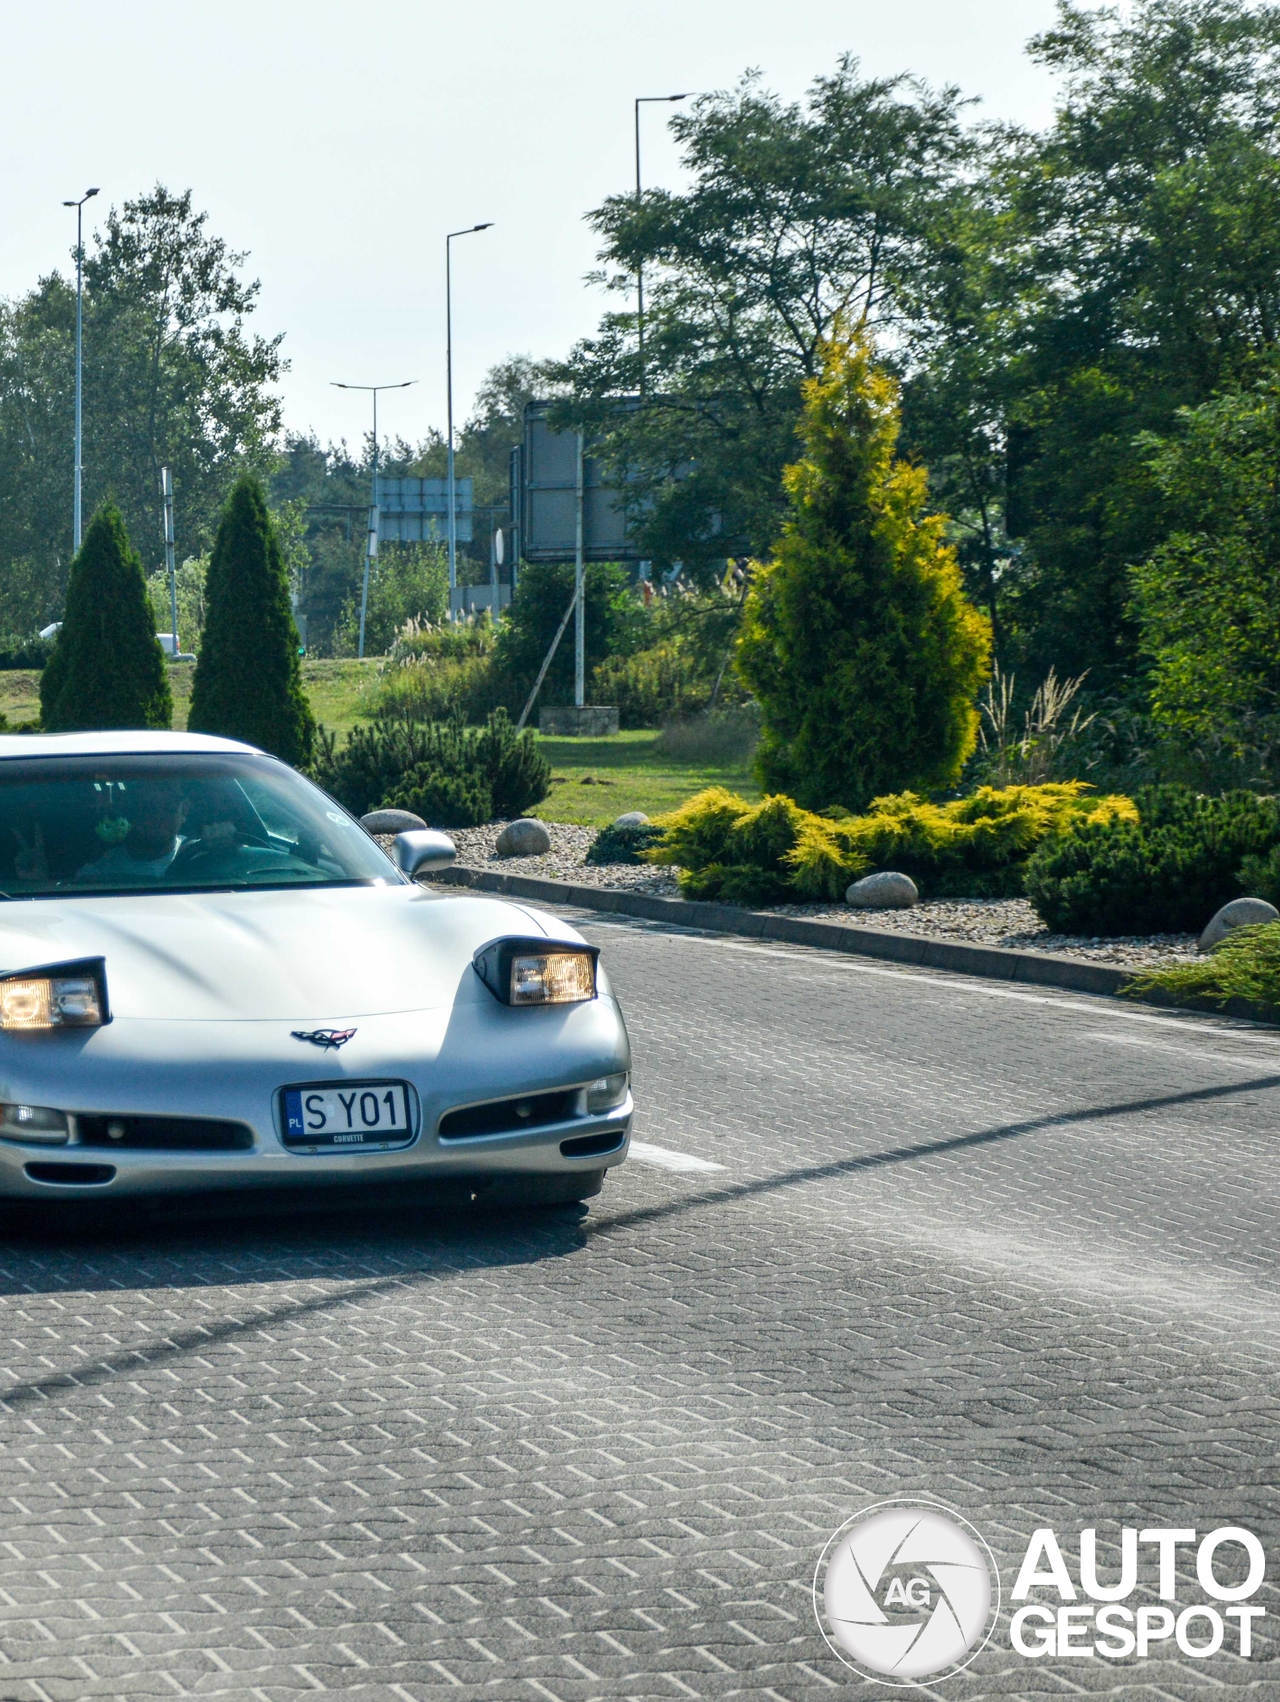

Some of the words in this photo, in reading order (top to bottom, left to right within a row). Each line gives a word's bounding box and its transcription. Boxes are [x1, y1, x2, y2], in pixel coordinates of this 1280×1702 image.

[305, 1094, 327, 1130] S
[337, 1090, 396, 1128] Y01
[288, 1118, 302, 1128] PL
[333, 1134, 364, 1143] CORVETTE
